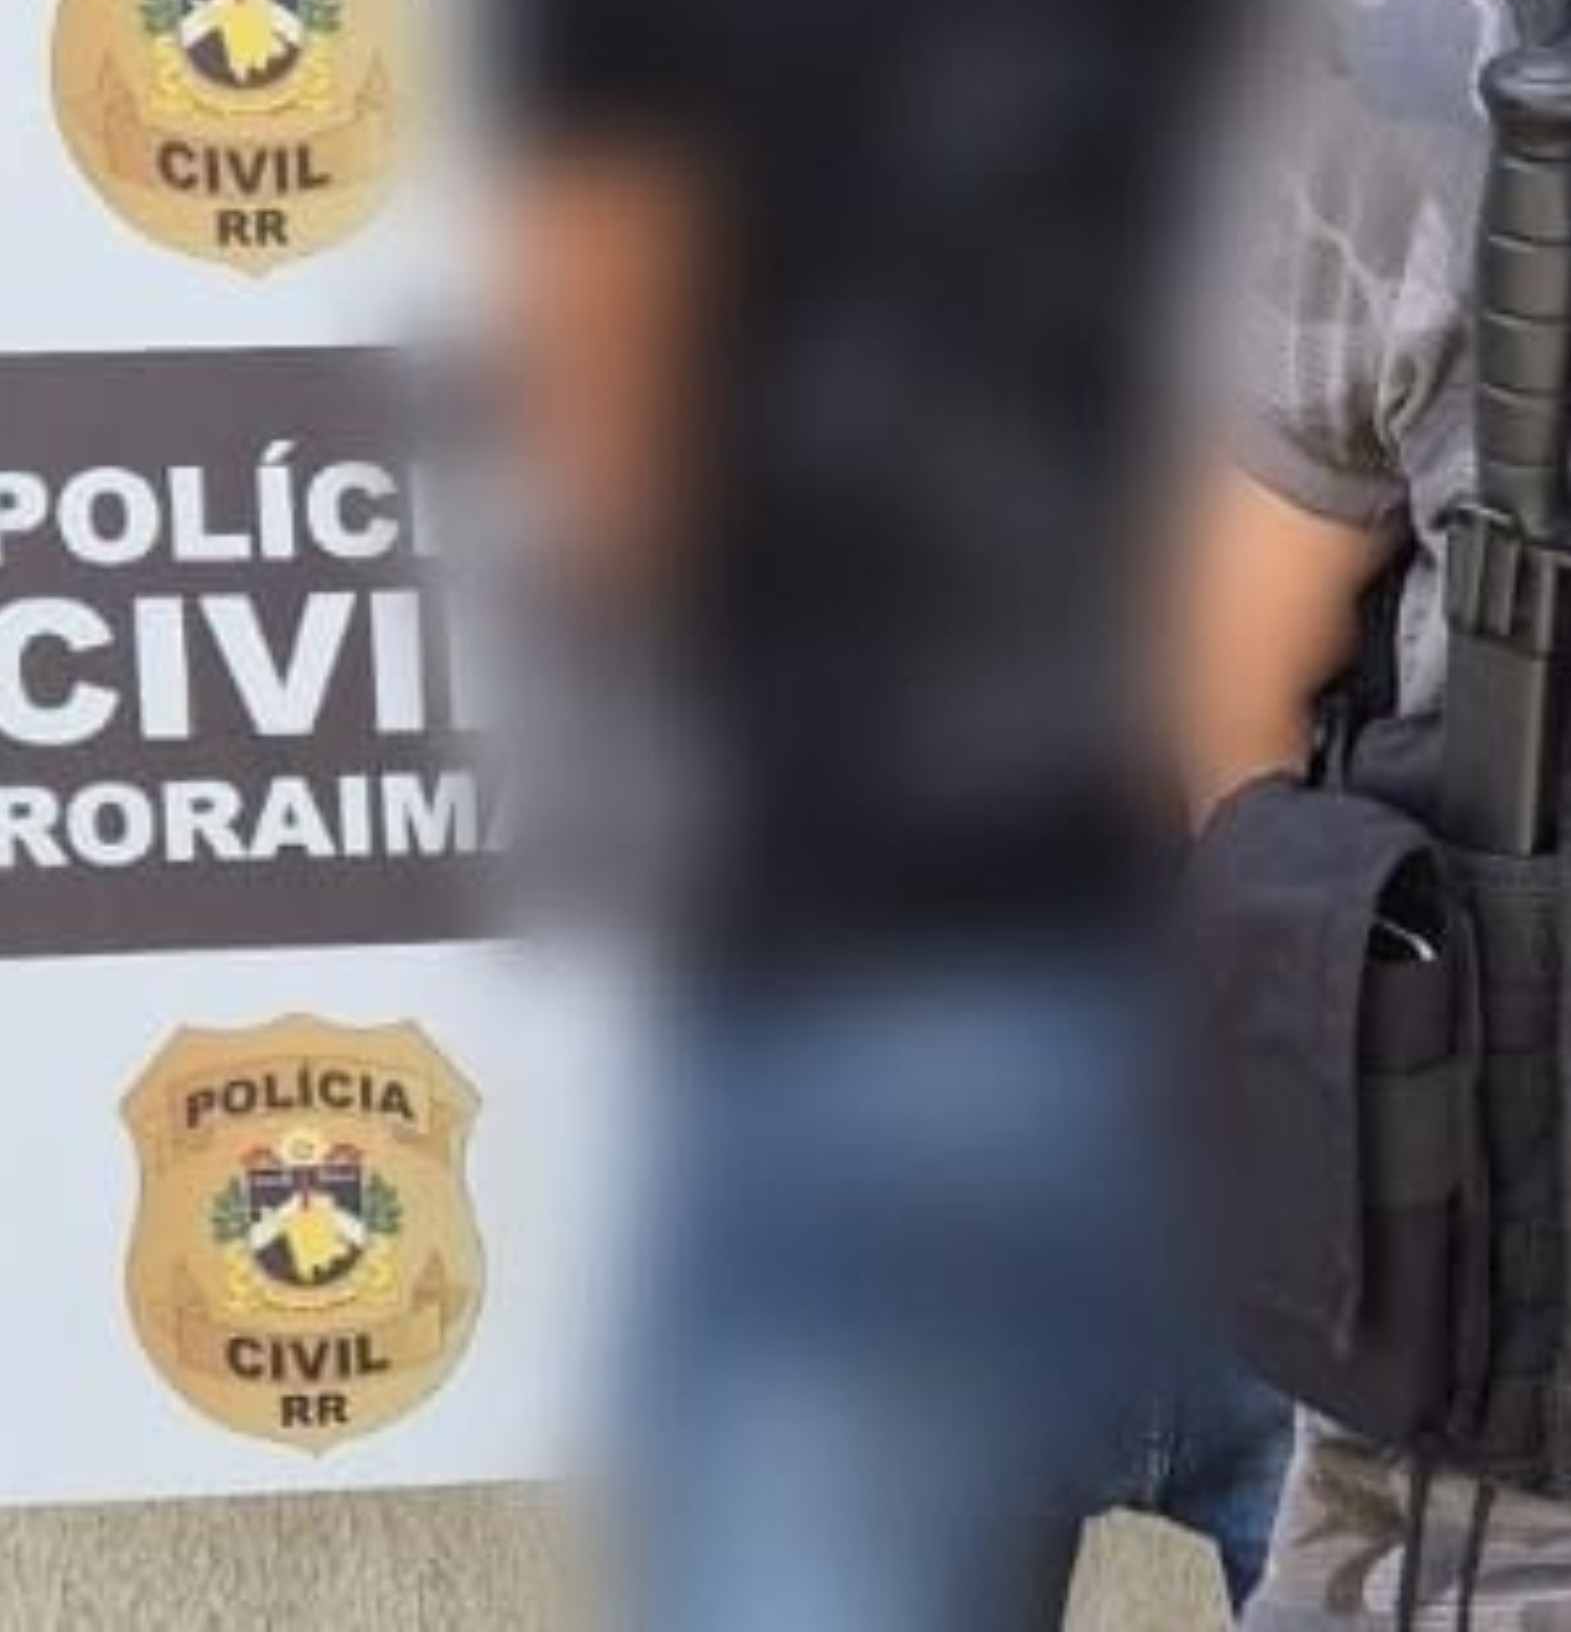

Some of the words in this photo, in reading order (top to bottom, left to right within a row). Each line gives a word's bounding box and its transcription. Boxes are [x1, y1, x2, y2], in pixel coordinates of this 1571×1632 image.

[155, 139, 332, 195] CIVIL
[217, 210, 289, 247] RR
[184, 1059, 416, 1128] POLÍCIA
[224, 1332, 392, 1383] CIVIL
[280, 1395, 350, 1428] RR
